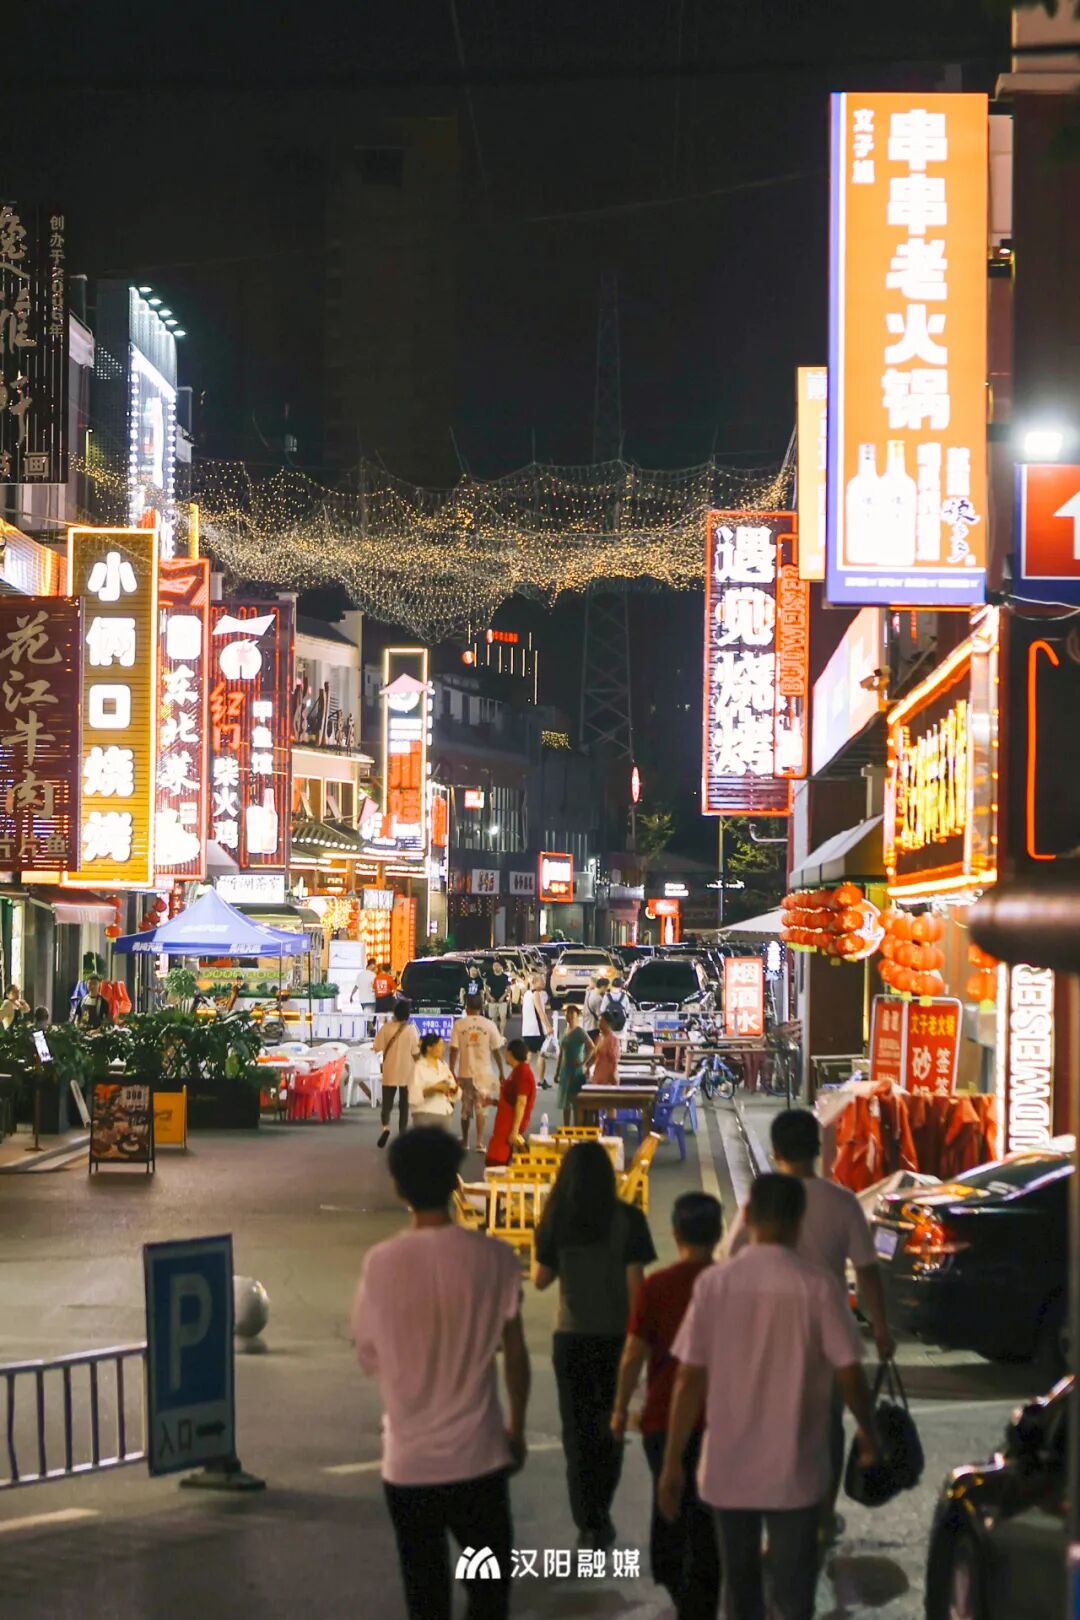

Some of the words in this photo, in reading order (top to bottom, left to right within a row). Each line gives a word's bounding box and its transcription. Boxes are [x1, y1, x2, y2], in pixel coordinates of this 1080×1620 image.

[881, 108, 950, 430] 串串老火锅
[0, 611, 62, 820] 花江牛肉
[84, 551, 137, 862] 小俩口烧烤
[161, 664, 201, 797] 东北菜
[715, 525, 777, 776] 遇见烧烤
[1009, 964, 1052, 1152] UDWEISER
[170, 1273, 213, 1392] P
[159, 1419, 193, 1457] 入口
